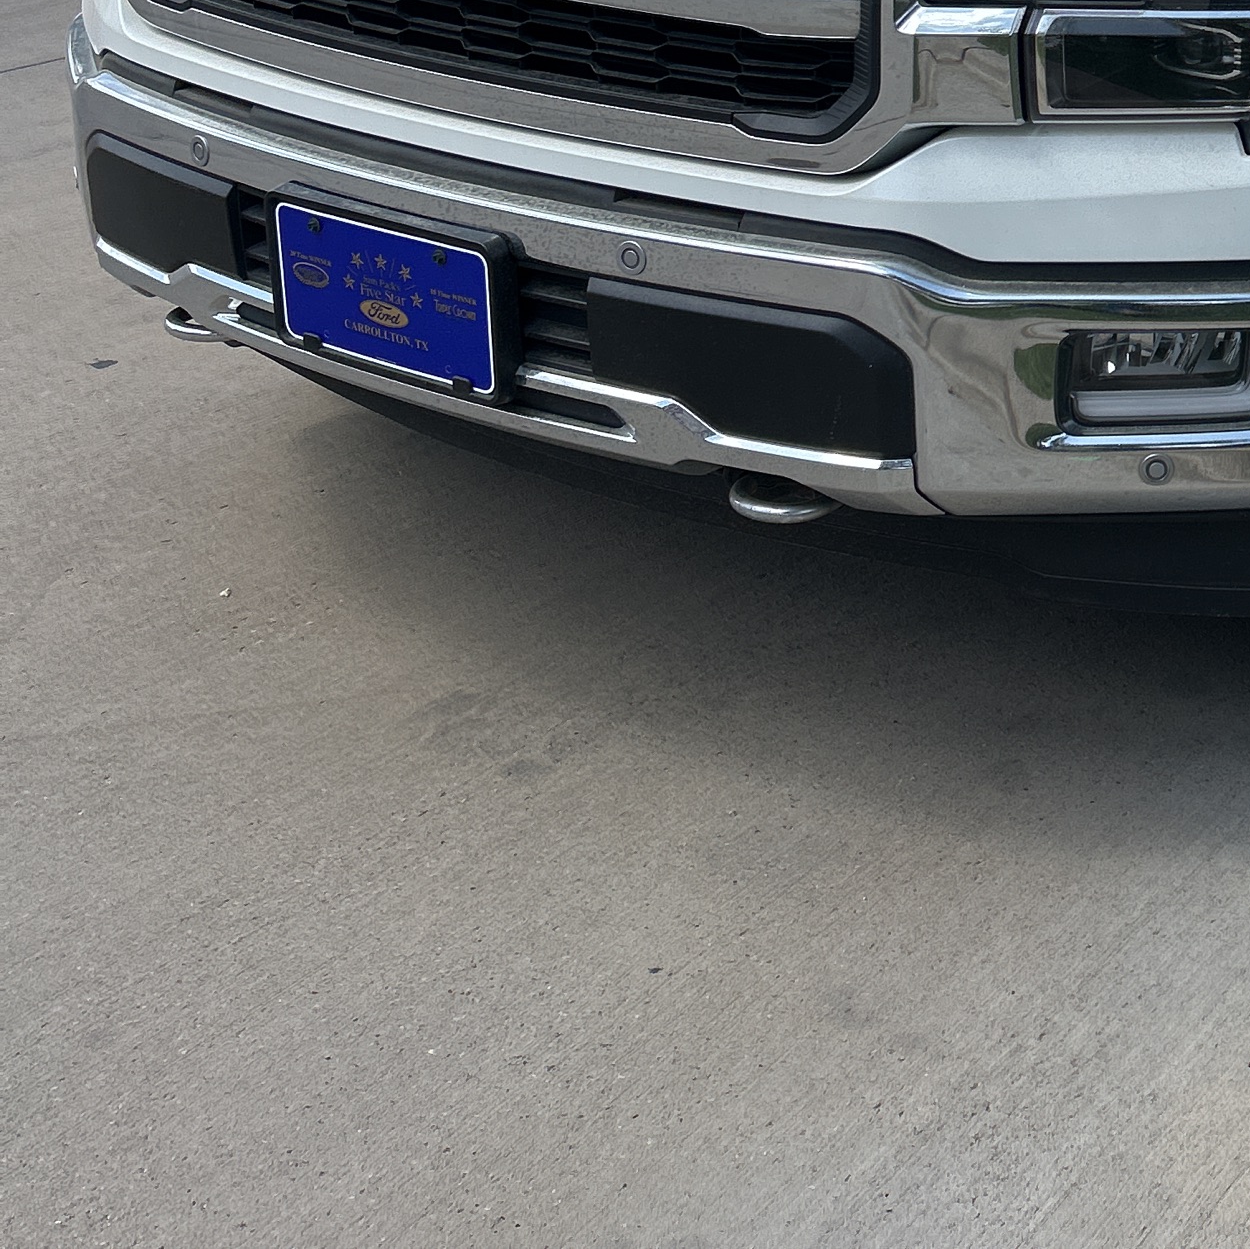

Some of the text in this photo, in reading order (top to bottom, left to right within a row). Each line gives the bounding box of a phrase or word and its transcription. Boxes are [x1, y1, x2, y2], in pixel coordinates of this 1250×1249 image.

[360, 282, 407, 307] Five Star
[367, 301, 401, 325] Ford
[344, 318, 429, 351] CARROLLTON, TX
